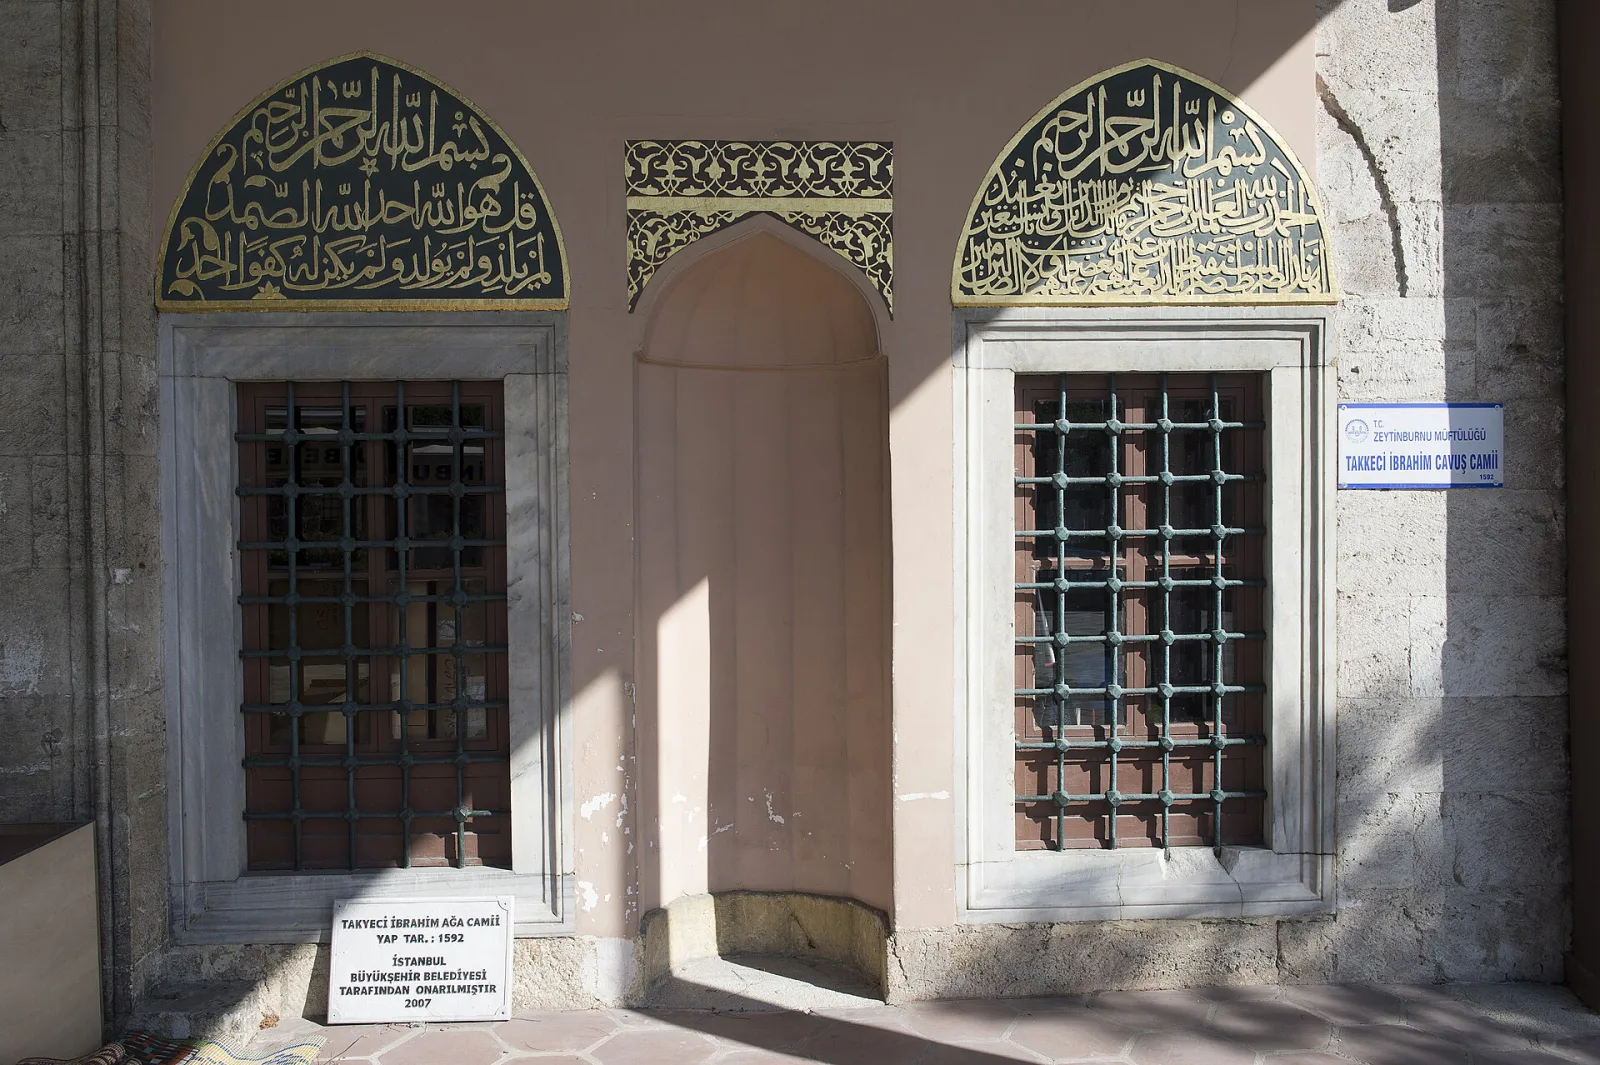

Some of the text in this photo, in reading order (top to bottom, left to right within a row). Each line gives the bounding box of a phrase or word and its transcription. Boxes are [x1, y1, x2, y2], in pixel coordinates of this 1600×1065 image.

[1373, 428, 1432, 442] ZEYTİNBURNU
[1435, 427, 1486, 441] MÜFTÜLÜĞÜ
[1346, 449, 1498, 474] TAKKECİ İBRAHİM CAVUŞ CAMİİ
[341, 914, 501, 929] TAKYECİ İBRAHİM AĞA CAMİİ
[376, 934, 398, 944] YAP
[403, 934, 429, 943] TAR.
[438, 934, 464, 943] 1592
[392, 954, 446, 967] İSTANBUL
[350, 968, 487, 984] BÜYÜKŞEHİR BELEDİYESİ
[339, 984, 497, 996] TARAFINDAN ONARILMIŞTIR
[404, 999, 432, 1008] 2007
